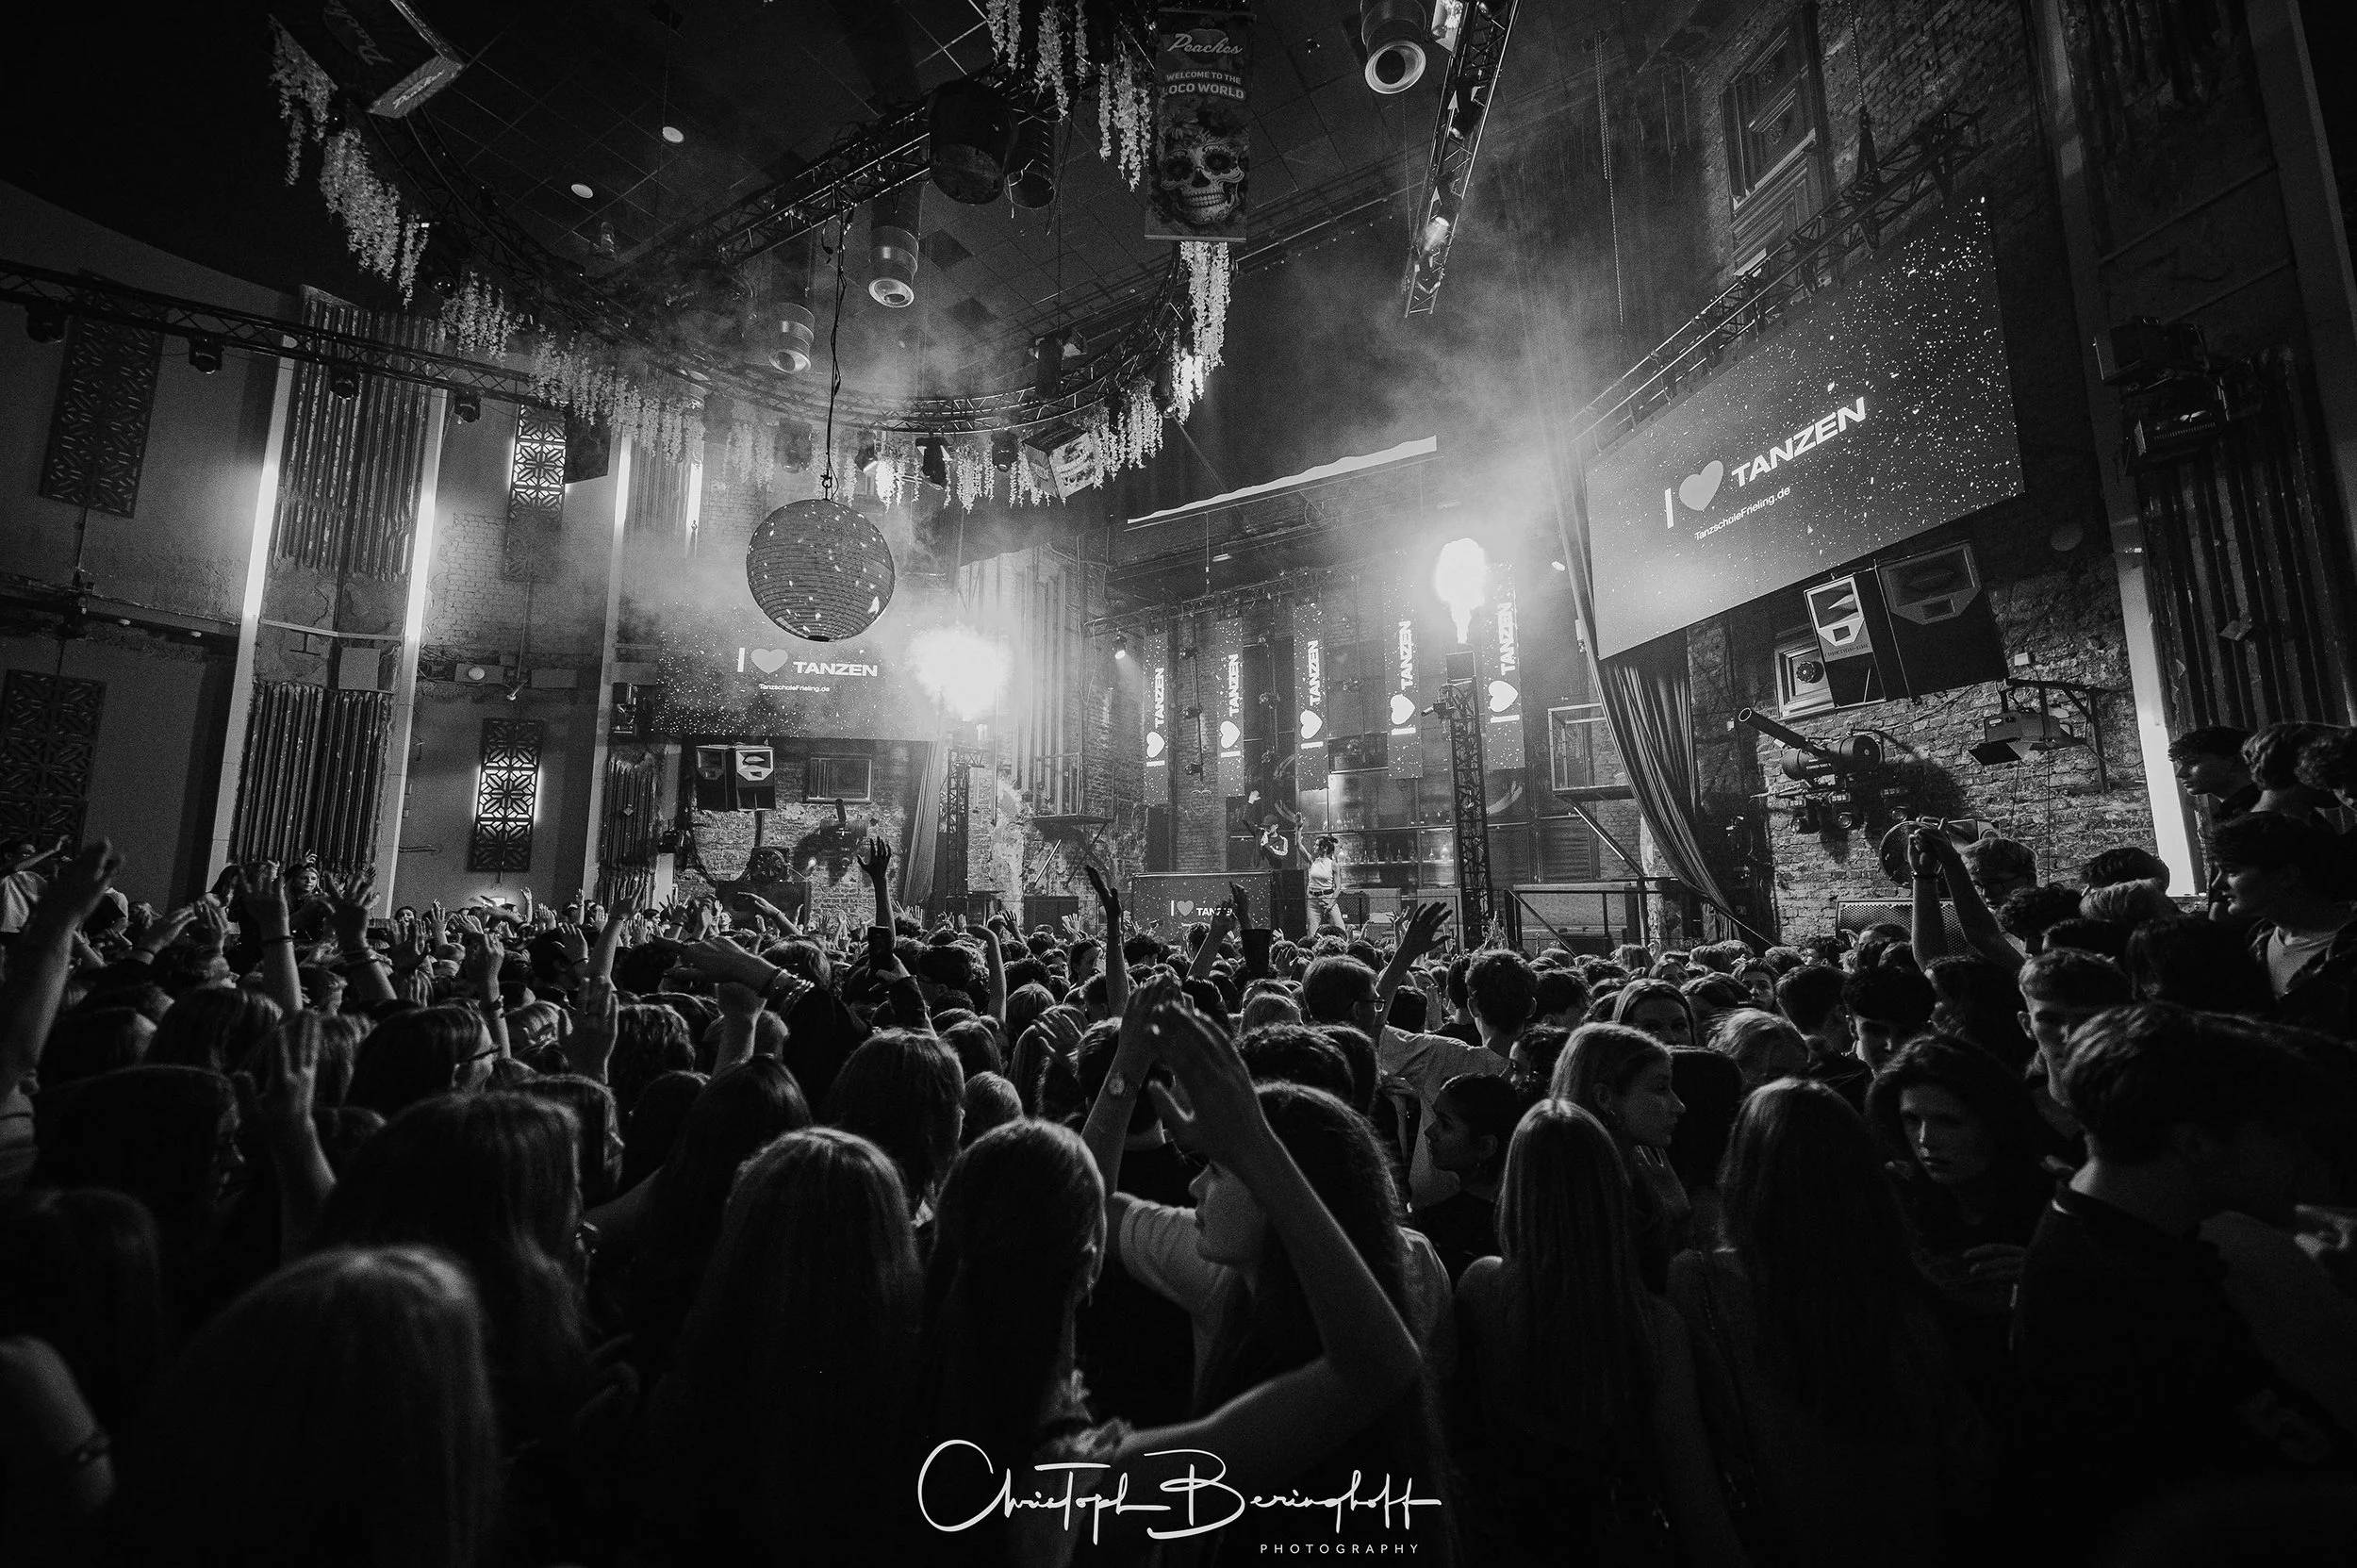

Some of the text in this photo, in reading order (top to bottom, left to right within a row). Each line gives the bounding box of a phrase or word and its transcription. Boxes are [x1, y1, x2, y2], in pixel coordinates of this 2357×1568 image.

[1167, 33, 1243, 54] Peaches
[1166, 71, 1242, 84] WELCOME TO THE
[1197, 83, 1244, 99] WORLD
[1664, 396, 1866, 529] I TANZEN
[1694, 487, 1791, 540] TanzschuleFrieling.de
[737, 648, 878, 677] I TANZEN
[1398, 620, 1413, 691] TANZEN
[1497, 602, 1516, 676] TANZEN
[1154, 668, 1165, 729] TANZEN
[1228, 653, 1240, 718] TANZEN
[1308, 640, 1321, 707] TANZEN
